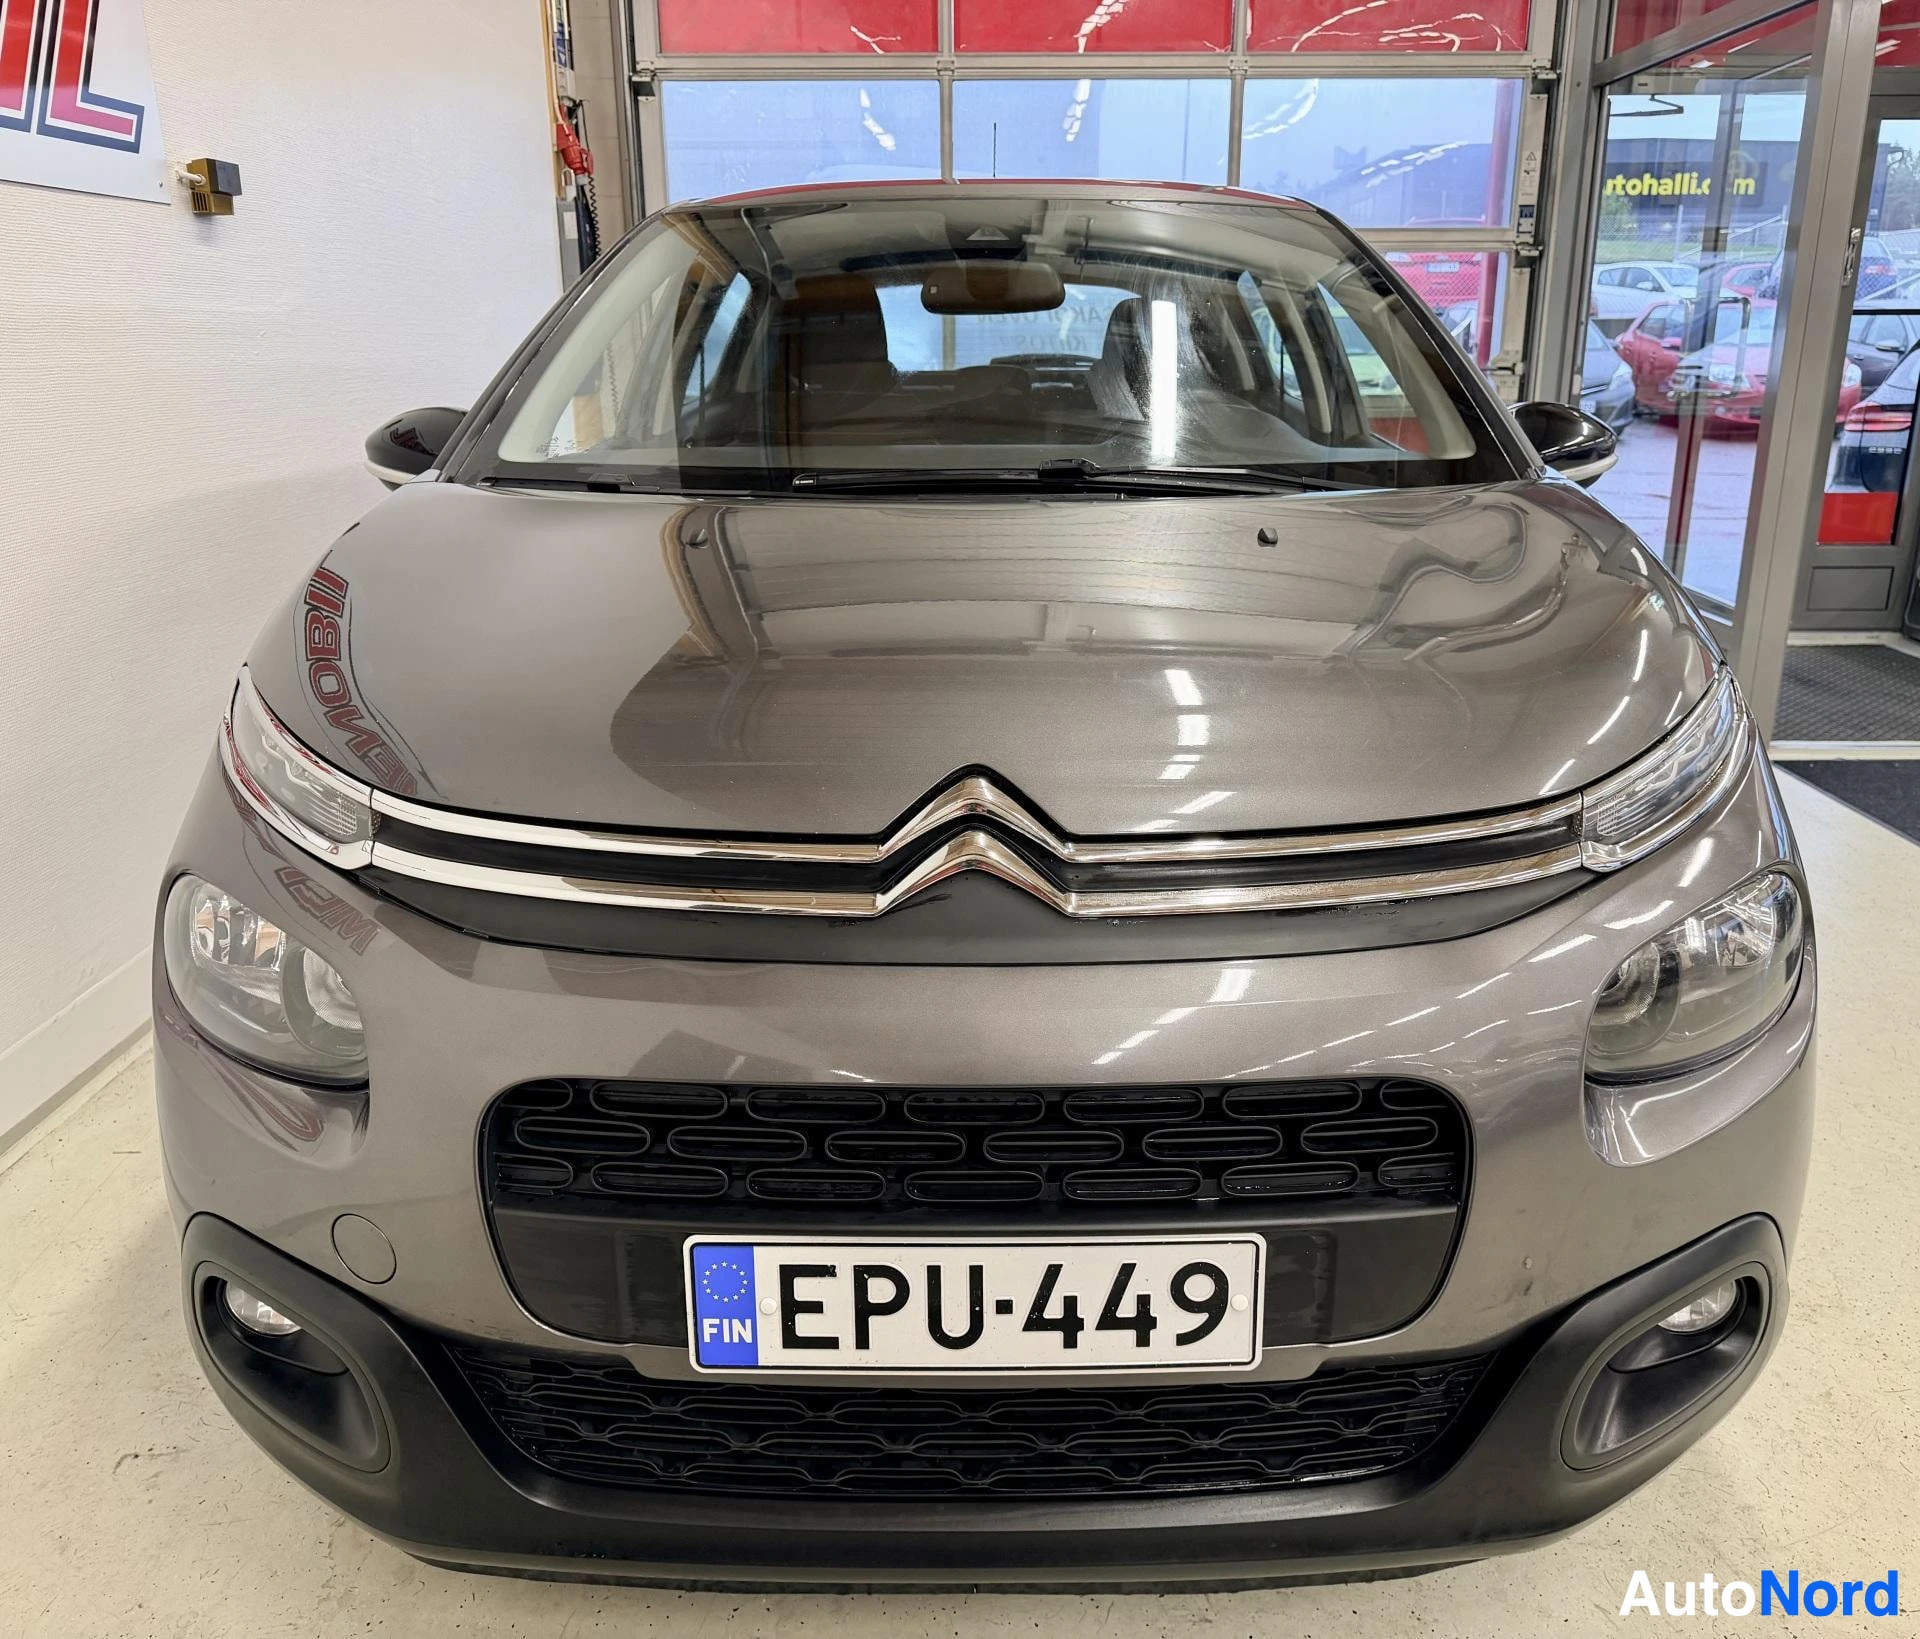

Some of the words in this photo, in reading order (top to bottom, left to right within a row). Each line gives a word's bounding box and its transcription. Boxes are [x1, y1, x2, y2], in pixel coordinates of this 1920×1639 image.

[1604, 171, 1756, 196] tohalli.cm
[778, 1261, 1230, 1350] EPU-449
[702, 1317, 753, 1344] FIN
